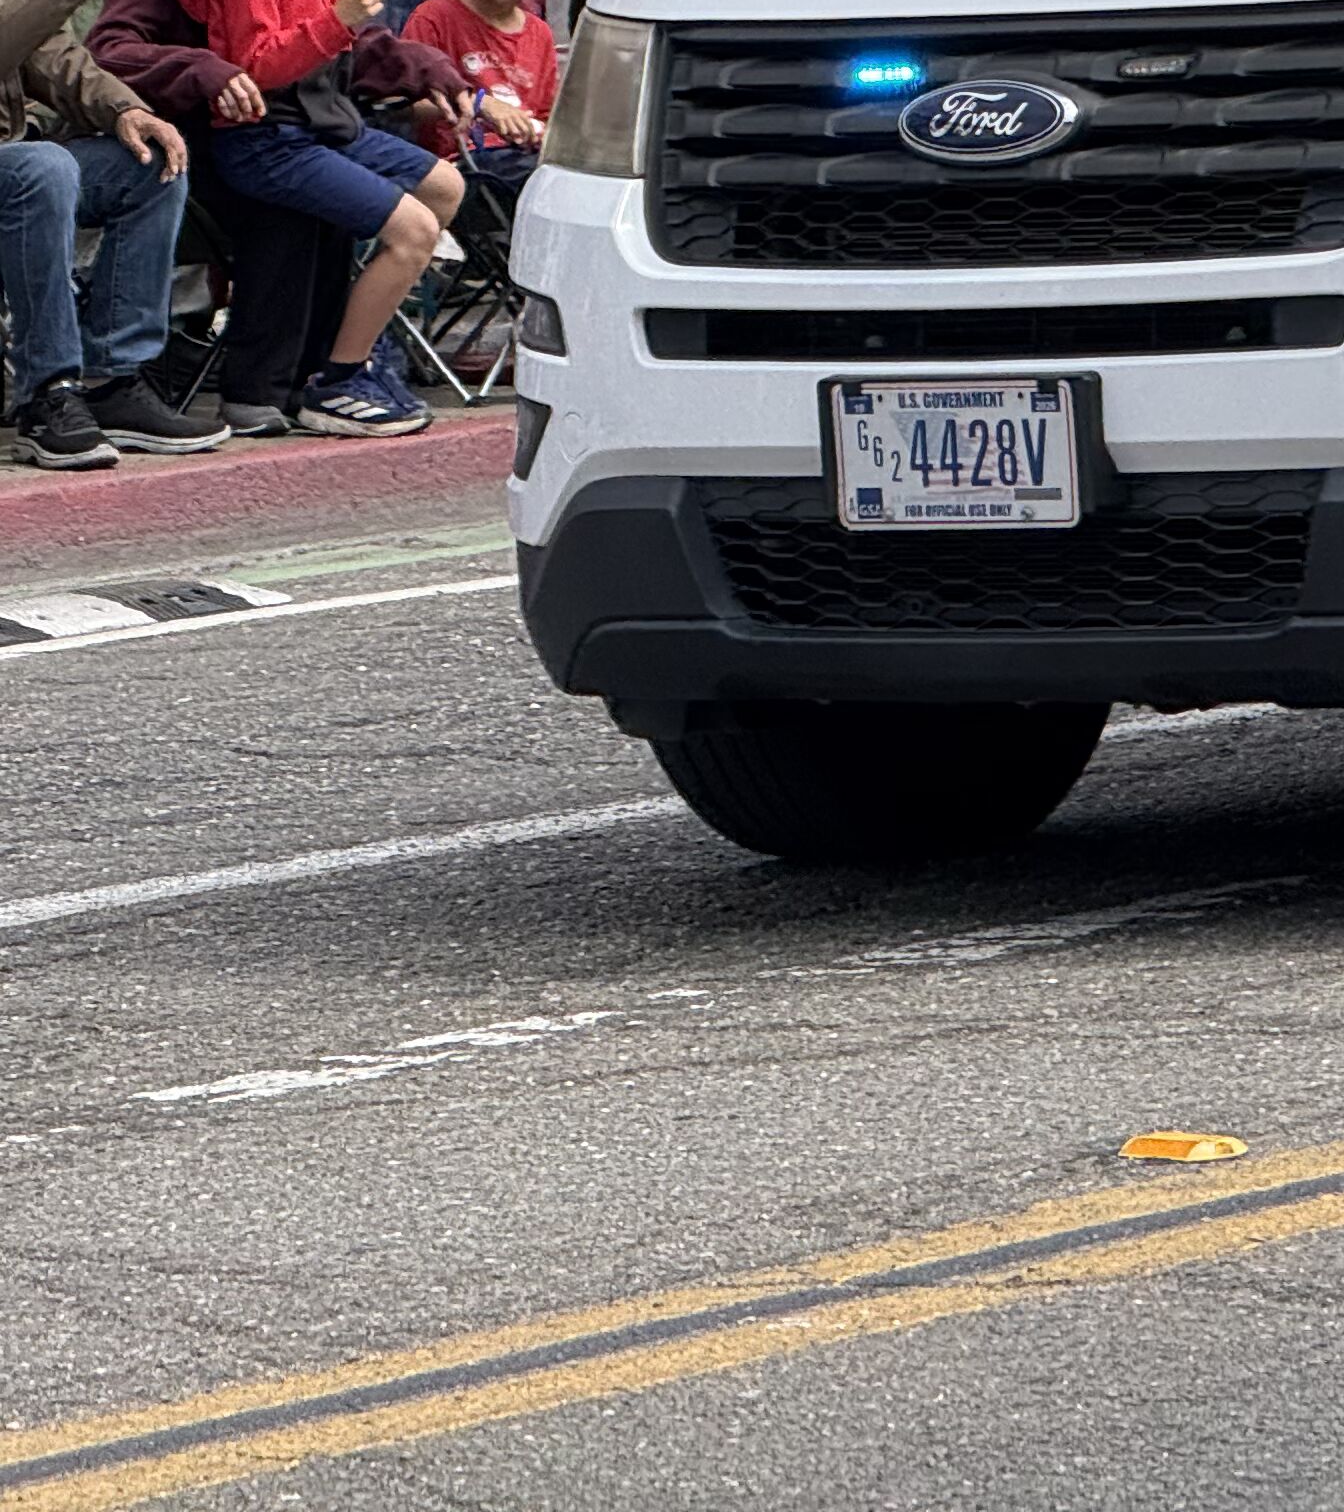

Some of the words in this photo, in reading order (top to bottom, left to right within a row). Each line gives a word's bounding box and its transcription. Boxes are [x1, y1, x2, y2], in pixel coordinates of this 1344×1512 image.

[929, 91, 1029, 139] Ford
[897, 392, 921, 409] U.S.
[923, 391, 1005, 408] GOVERNMENT
[910, 418, 1047, 488] 4428V
[905, 503, 923, 517] FOR
[925, 503, 967, 517] OFFICIAL
